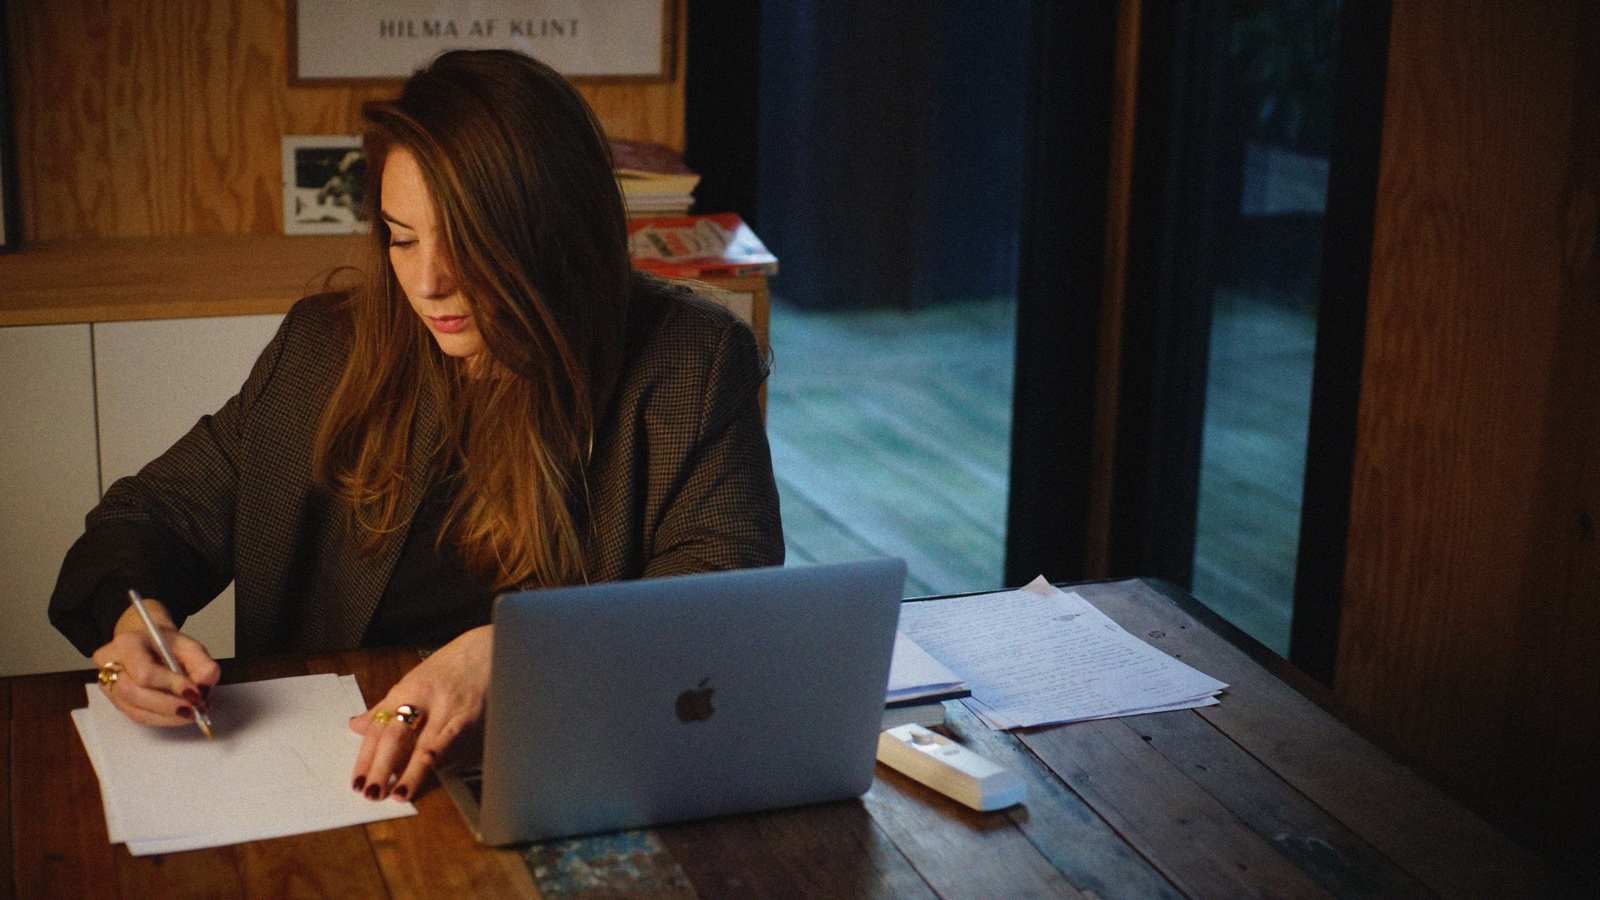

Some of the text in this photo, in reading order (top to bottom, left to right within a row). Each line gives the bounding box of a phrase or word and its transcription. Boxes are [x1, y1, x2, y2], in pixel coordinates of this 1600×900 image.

[380, 18, 578, 37] HILMA AF KLINT
